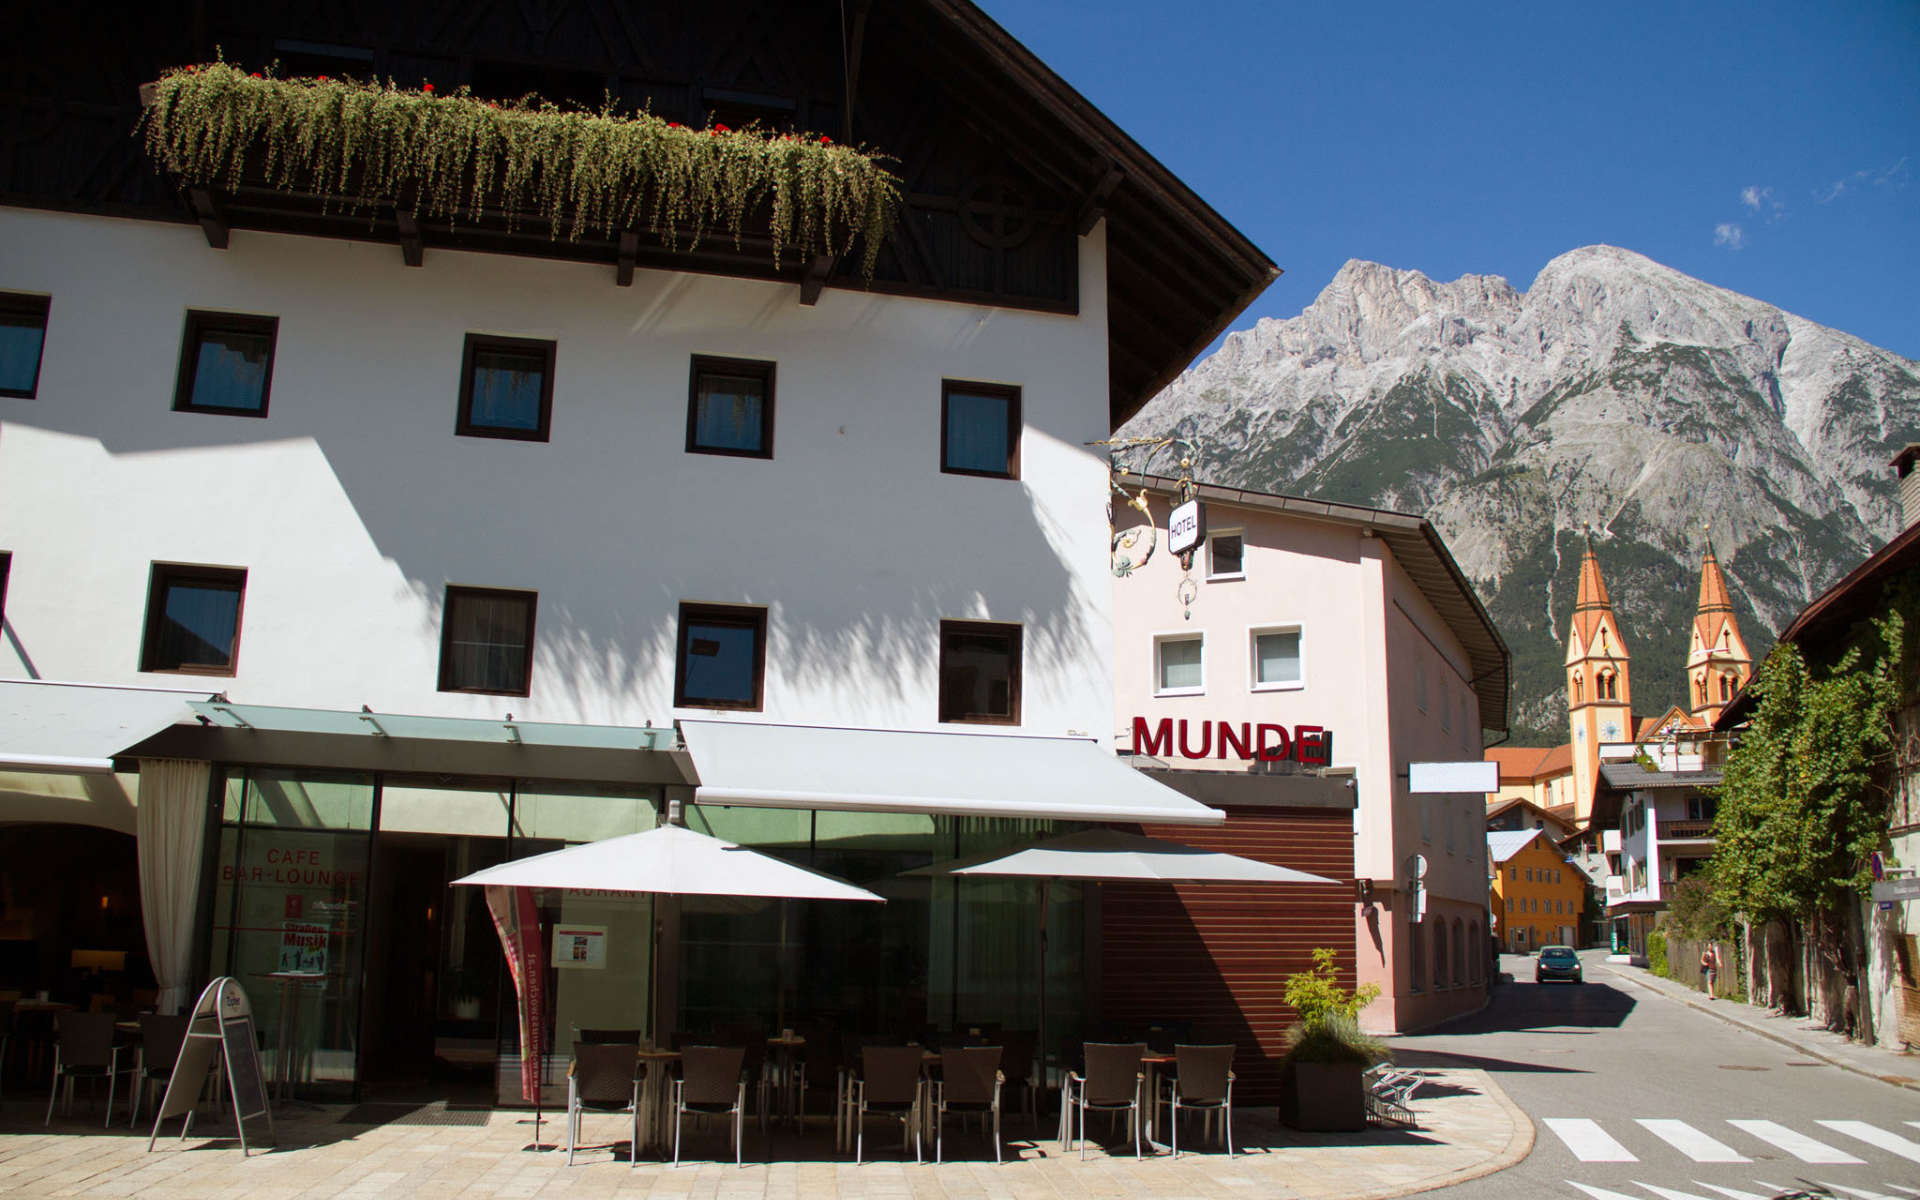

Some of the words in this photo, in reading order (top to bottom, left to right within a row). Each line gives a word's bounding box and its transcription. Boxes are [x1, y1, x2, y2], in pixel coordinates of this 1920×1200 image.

[1171, 515, 1197, 539] HOTEL
[1132, 716, 1326, 765] MUNDE
[267, 849, 321, 866] CAFE
[283, 933, 327, 948] Musik
